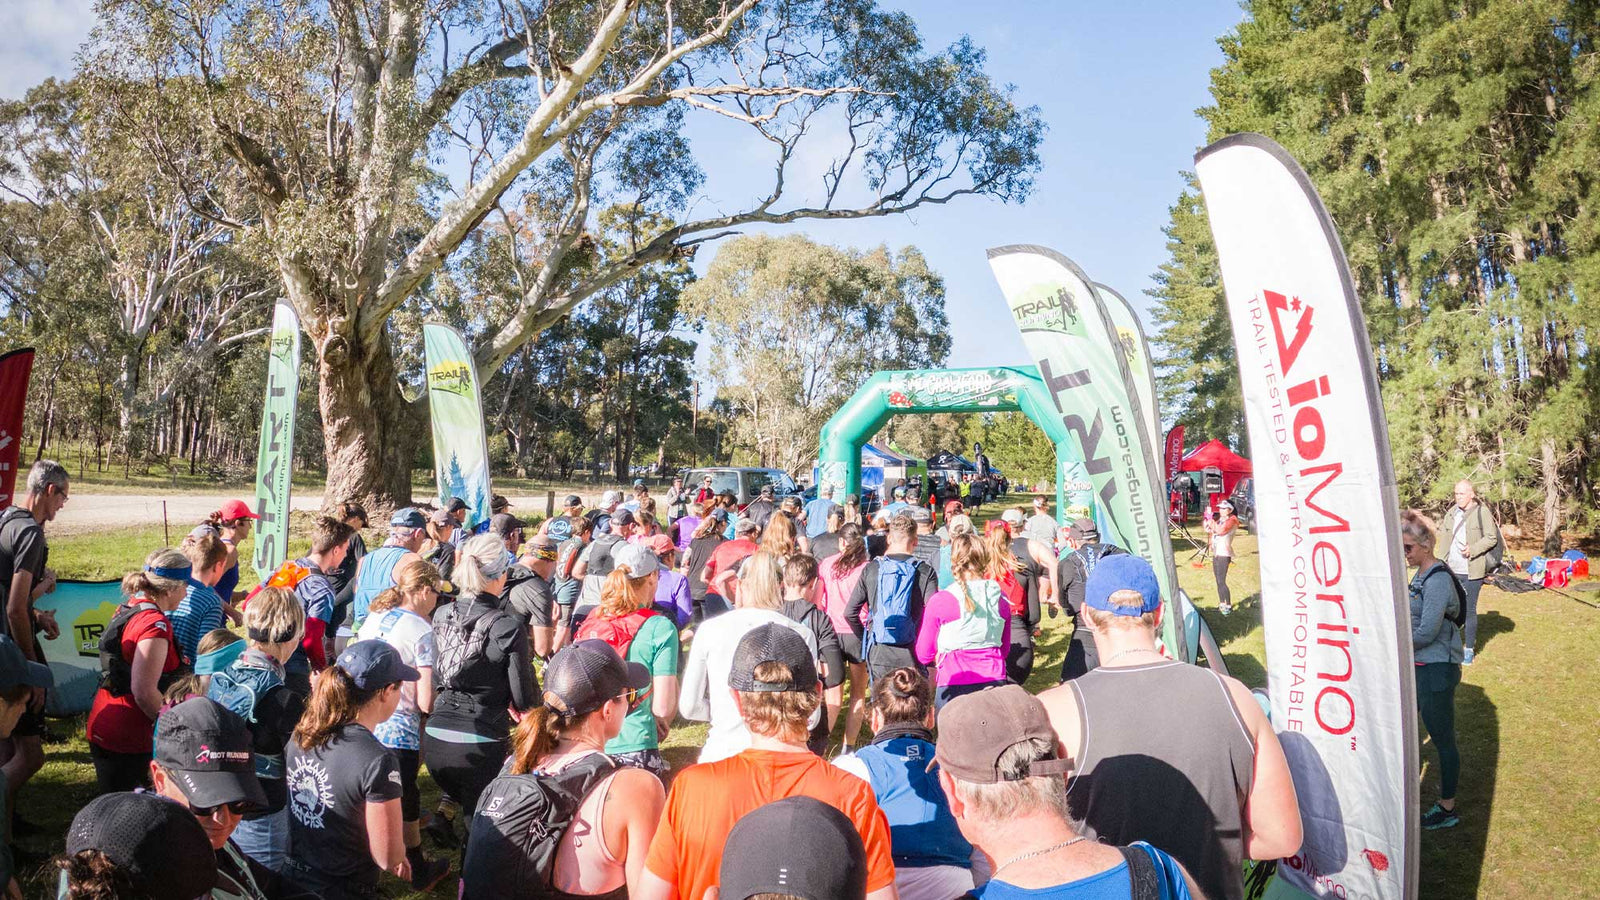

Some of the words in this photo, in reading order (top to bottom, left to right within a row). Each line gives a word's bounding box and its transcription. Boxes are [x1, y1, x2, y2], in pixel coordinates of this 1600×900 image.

[1013, 295, 1062, 320] TRAIL
[1247, 295, 1268, 355] TRAIL
[429, 369, 462, 381] TRAIL
[1263, 359, 1287, 444] TESTED
[256, 374, 286, 572] START
[1038, 357, 1134, 555] ART
[1280, 453, 1290, 466] &
[1285, 474, 1303, 548] ULTRA
[1287, 556, 1308, 733] COMFORTABLE
